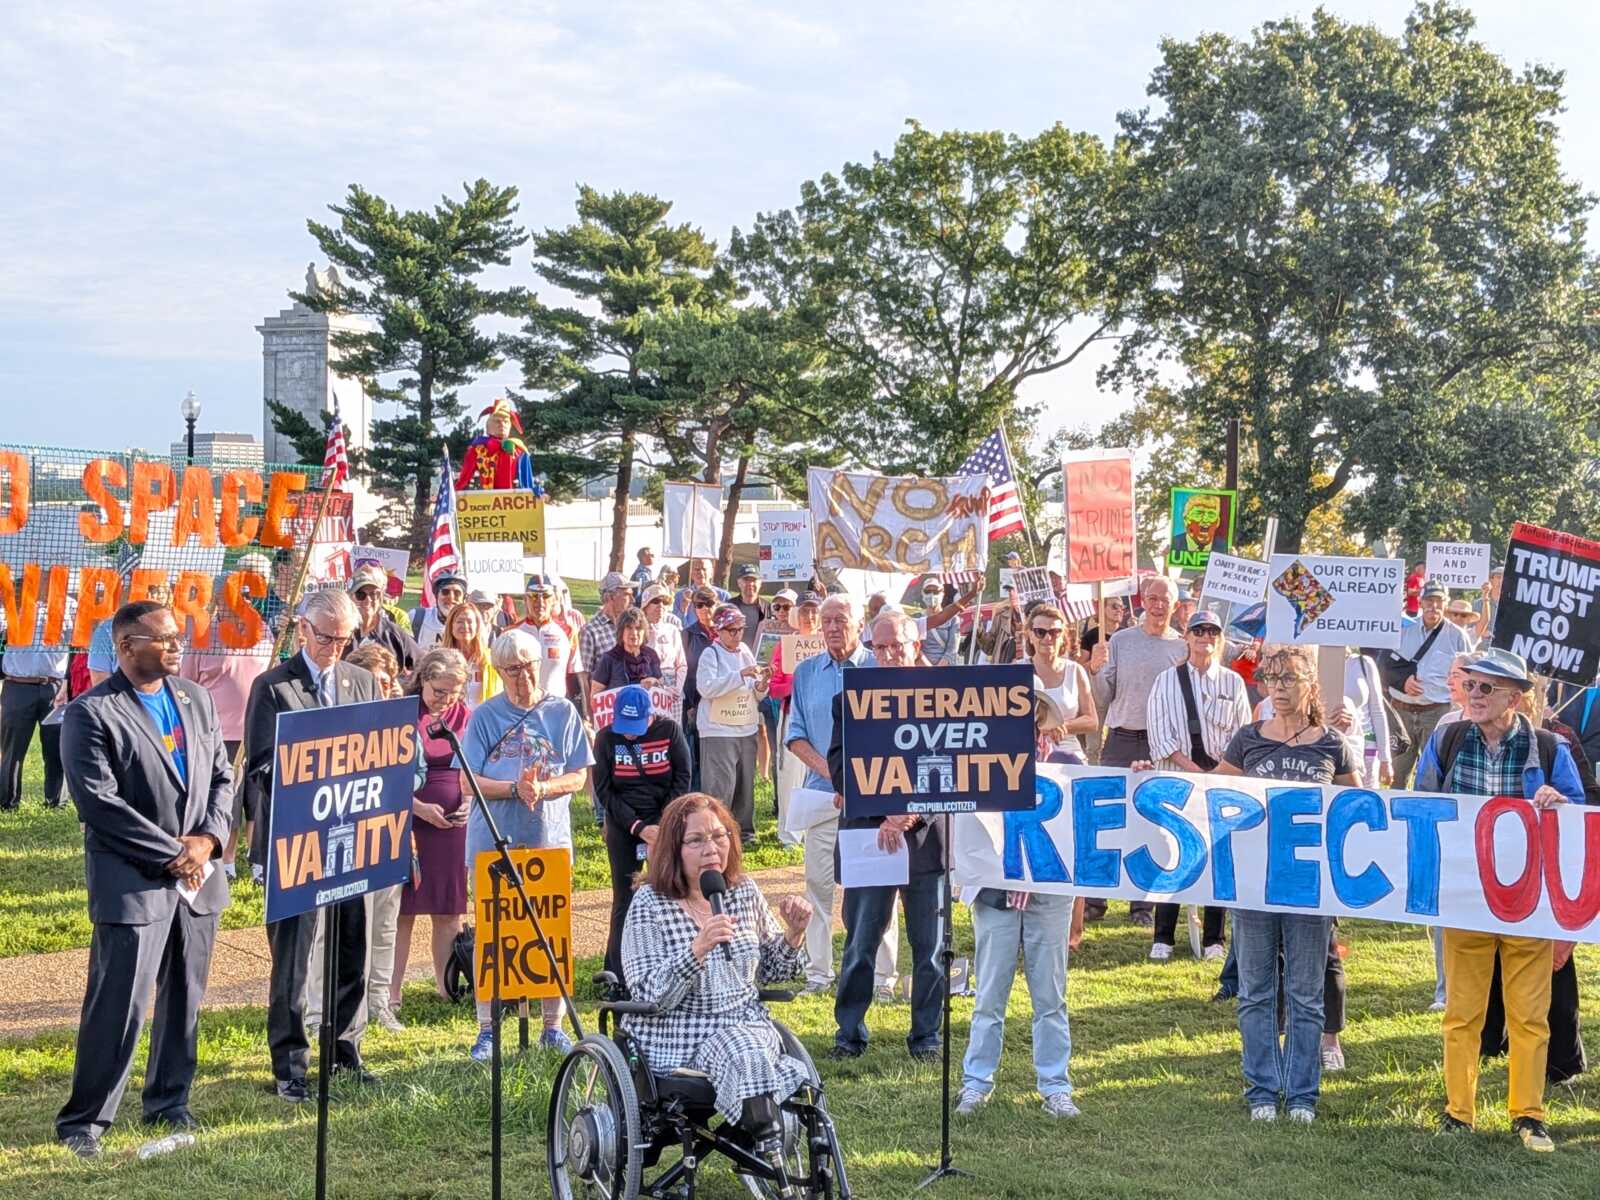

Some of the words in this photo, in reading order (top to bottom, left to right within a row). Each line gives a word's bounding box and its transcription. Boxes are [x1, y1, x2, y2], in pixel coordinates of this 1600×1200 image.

[1079, 465, 1124, 494] NO
[79, 458, 308, 548] SPACE
[492, 495, 537, 511] ARCH
[829, 471, 948, 521] NO
[468, 530, 538, 542] VETERANS
[763, 522, 779, 532] STOP
[1070, 507, 1133, 541] TRUMP
[816, 521, 977, 574] ARCH
[1077, 539, 1133, 572] ARCH
[1432, 545, 1484, 557] PRESERVE
[1222, 570, 1261, 586] DESERVE
[1313, 564, 1344, 577] OUR
[1348, 565, 1379, 578] CITY
[1383, 567, 1397, 578] IS
[1429, 573, 1477, 584] PROTECT
[1443, 559, 1467, 569] AND
[1513, 548, 1600, 591] TRUMP
[1013, 568, 1050, 594] HONK!
[1207, 580, 1259, 598] MEMORIALS
[1327, 581, 1397, 594] ALREADY
[1515, 578, 1593, 618] MUST
[1316, 618, 1399, 633] BEAUTIFUL
[1530, 610, 1570, 641] GO
[795, 639, 826, 649] ARCH
[1510, 634, 1585, 673] NOW!
[846, 685, 1032, 720] VETERANS
[894, 722, 989, 750] OVER
[278, 724, 415, 787] VETERANS
[1256, 760, 1275, 776] NO
[1282, 757, 1321, 780] KINGS
[850, 753, 1030, 795] VAITY
[312, 775, 384, 821] OVER
[276, 810, 409, 890] VAITY
[1003, 774, 1460, 916] RESPECT
[1474, 796, 1600, 931] OU
[481, 894, 567, 922] TRUMP
[479, 935, 570, 987] ARCH
